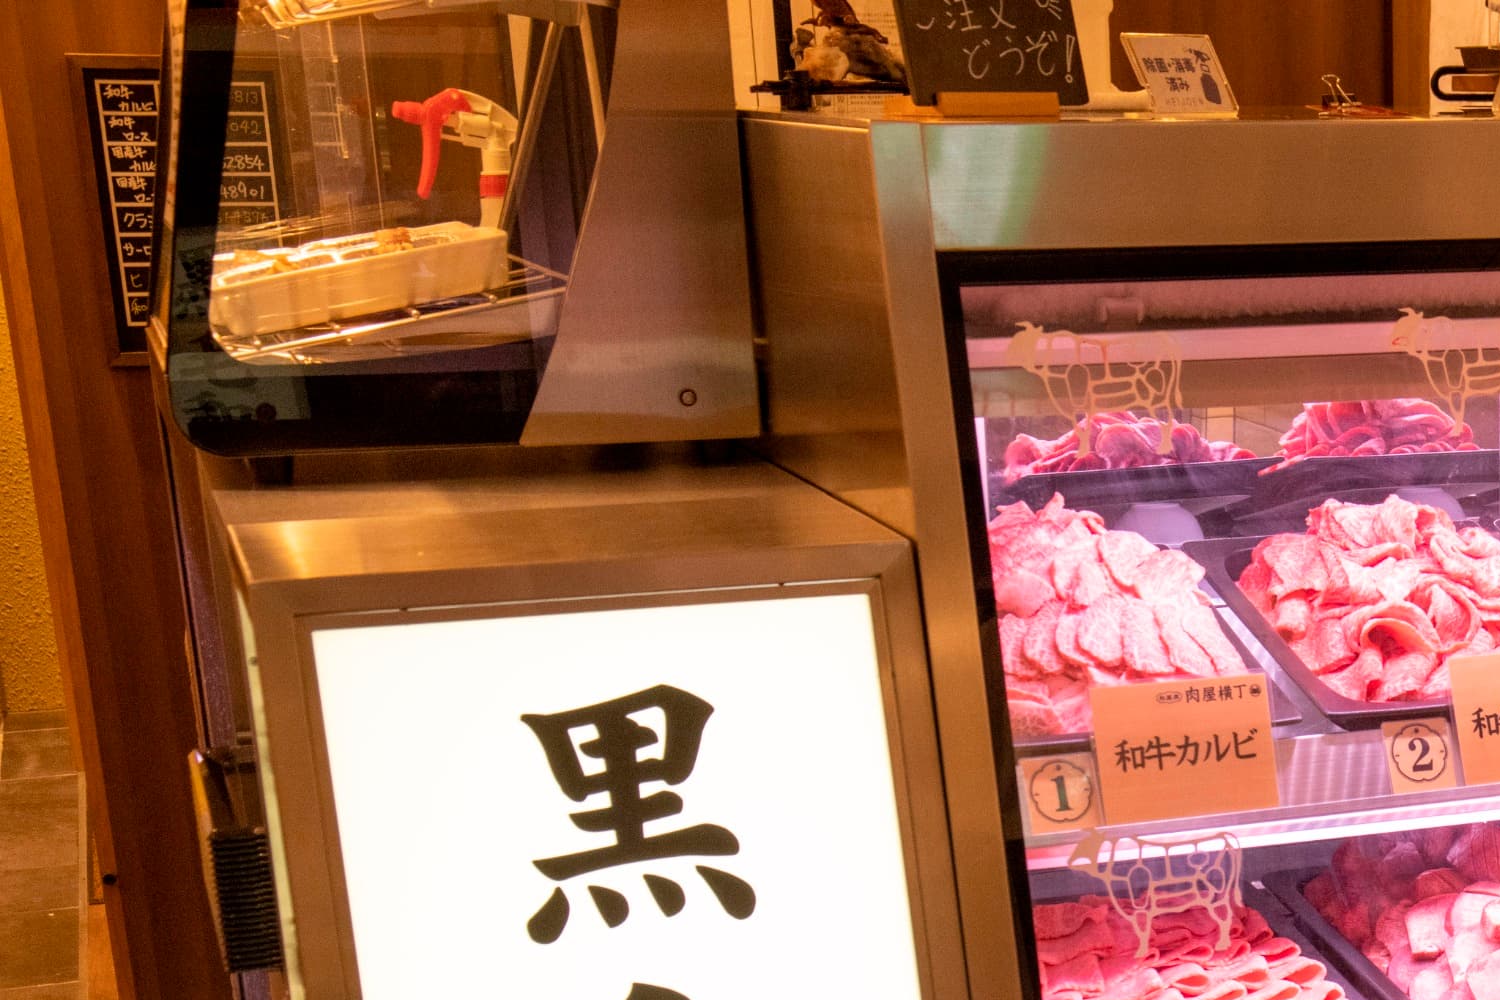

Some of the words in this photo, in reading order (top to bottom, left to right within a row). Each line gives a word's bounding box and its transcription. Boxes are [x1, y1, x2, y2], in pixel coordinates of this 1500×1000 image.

[1184, 683, 1247, 704] 肉屋横丁
[1114, 728, 1259, 772] 和牛カルビ
[1408, 737, 1433, 773] 2
[1050, 775, 1072, 812] 1
